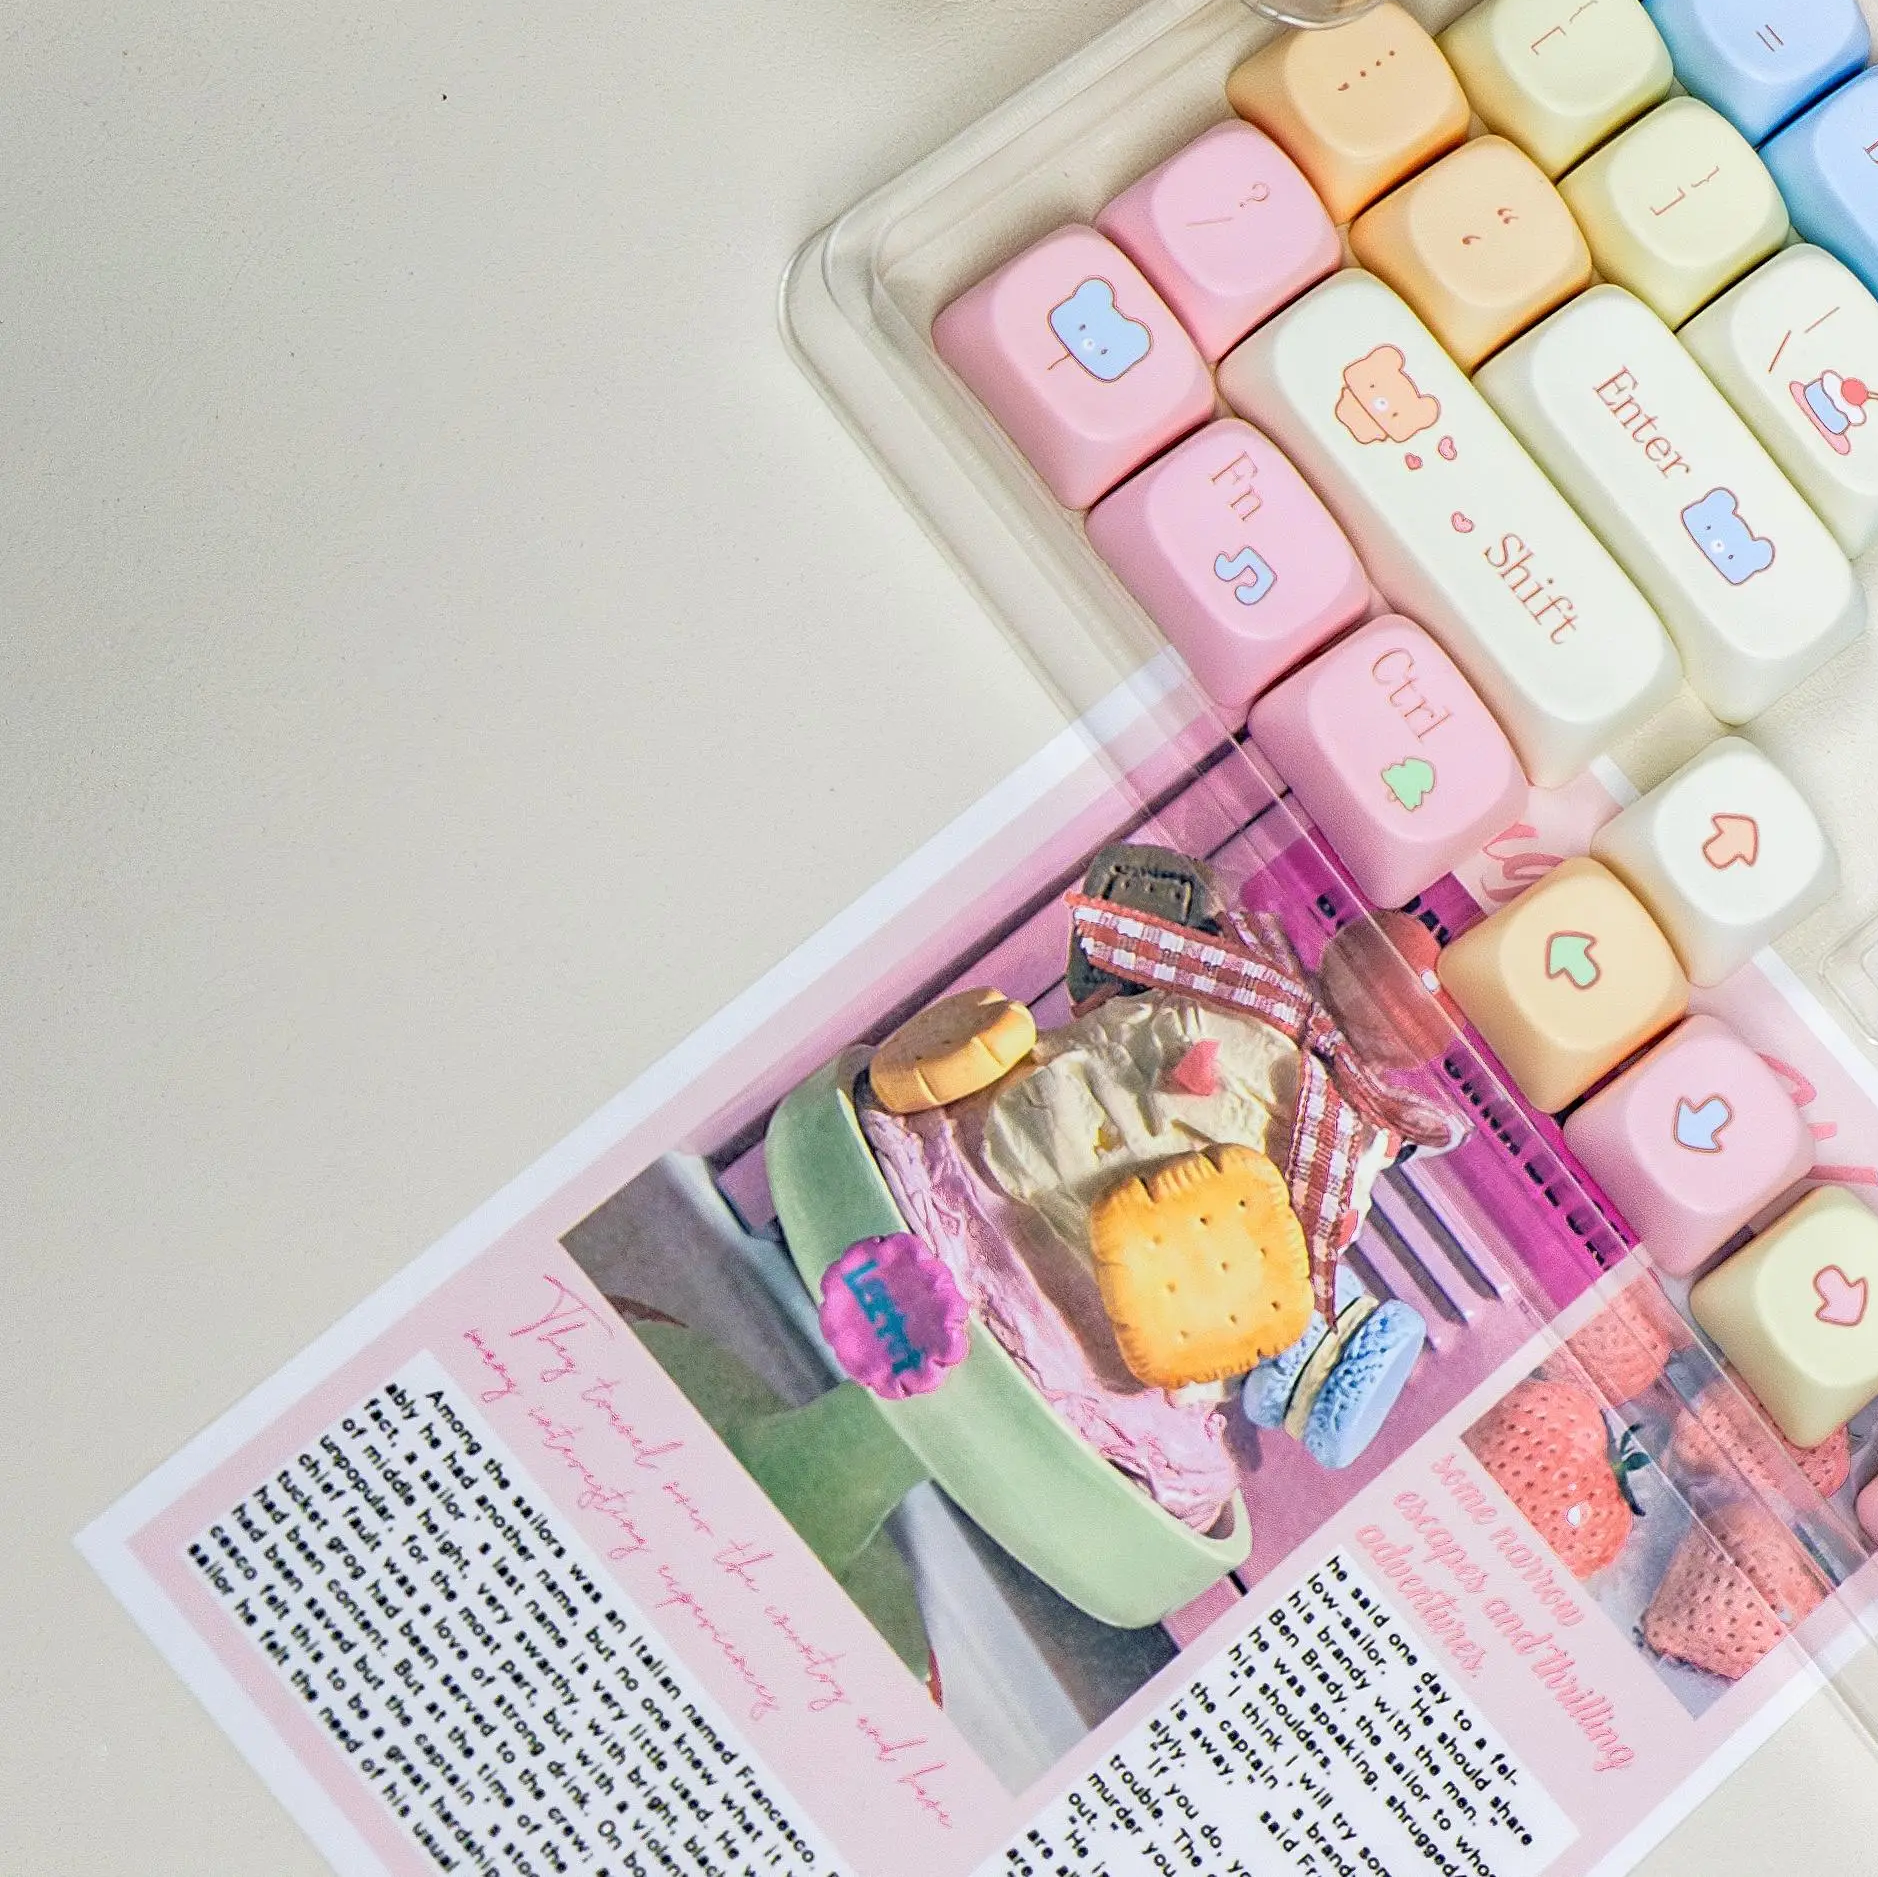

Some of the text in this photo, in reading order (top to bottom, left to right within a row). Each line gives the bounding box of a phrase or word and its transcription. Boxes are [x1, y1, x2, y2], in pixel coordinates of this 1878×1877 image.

[1593, 366, 1690, 478] Enter
[1211, 451, 1263, 522] Fn
[1484, 533, 1577, 644] Shift
[1372, 642, 1459, 739] Ctrl
[297, 1452, 347, 1502] chief
[318, 1433, 397, 1533] unpopular,
[362, 1444, 472, 1580] middle height,
[424, 1389, 821, 1870] Among the sailors was Italian named Francesco.
[474, 1493, 618, 1664] another name, but
[325, 1578, 427, 1698] content. But
[1315, 1624, 1413, 1743] brandy with
[1387, 1632, 1453, 1706] one day
[1267, 1607, 1432, 1804] Ben Brady, sailor
[1306, 1571, 1534, 1847] low-sailor. should share
